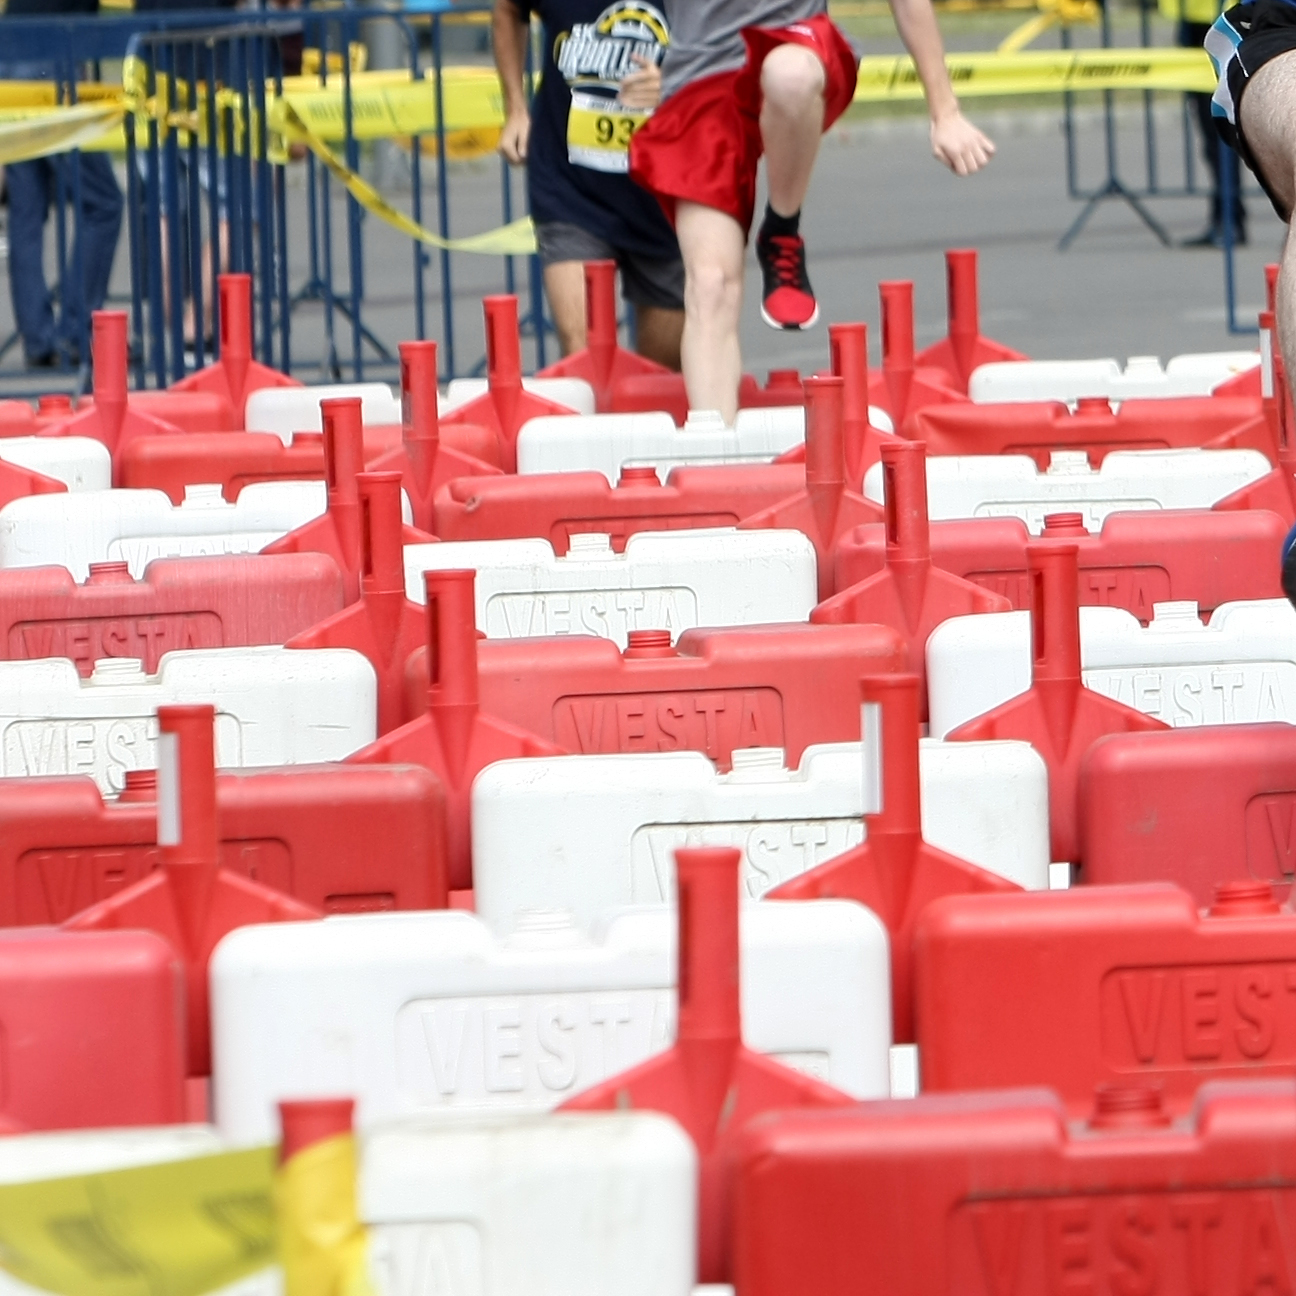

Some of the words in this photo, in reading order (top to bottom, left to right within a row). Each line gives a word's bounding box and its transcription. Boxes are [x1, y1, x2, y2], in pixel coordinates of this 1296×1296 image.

[18, 721, 158, 792] VES
[569, 692, 770, 760] VESTA
[971, 1188, 1296, 1296] VESTA
